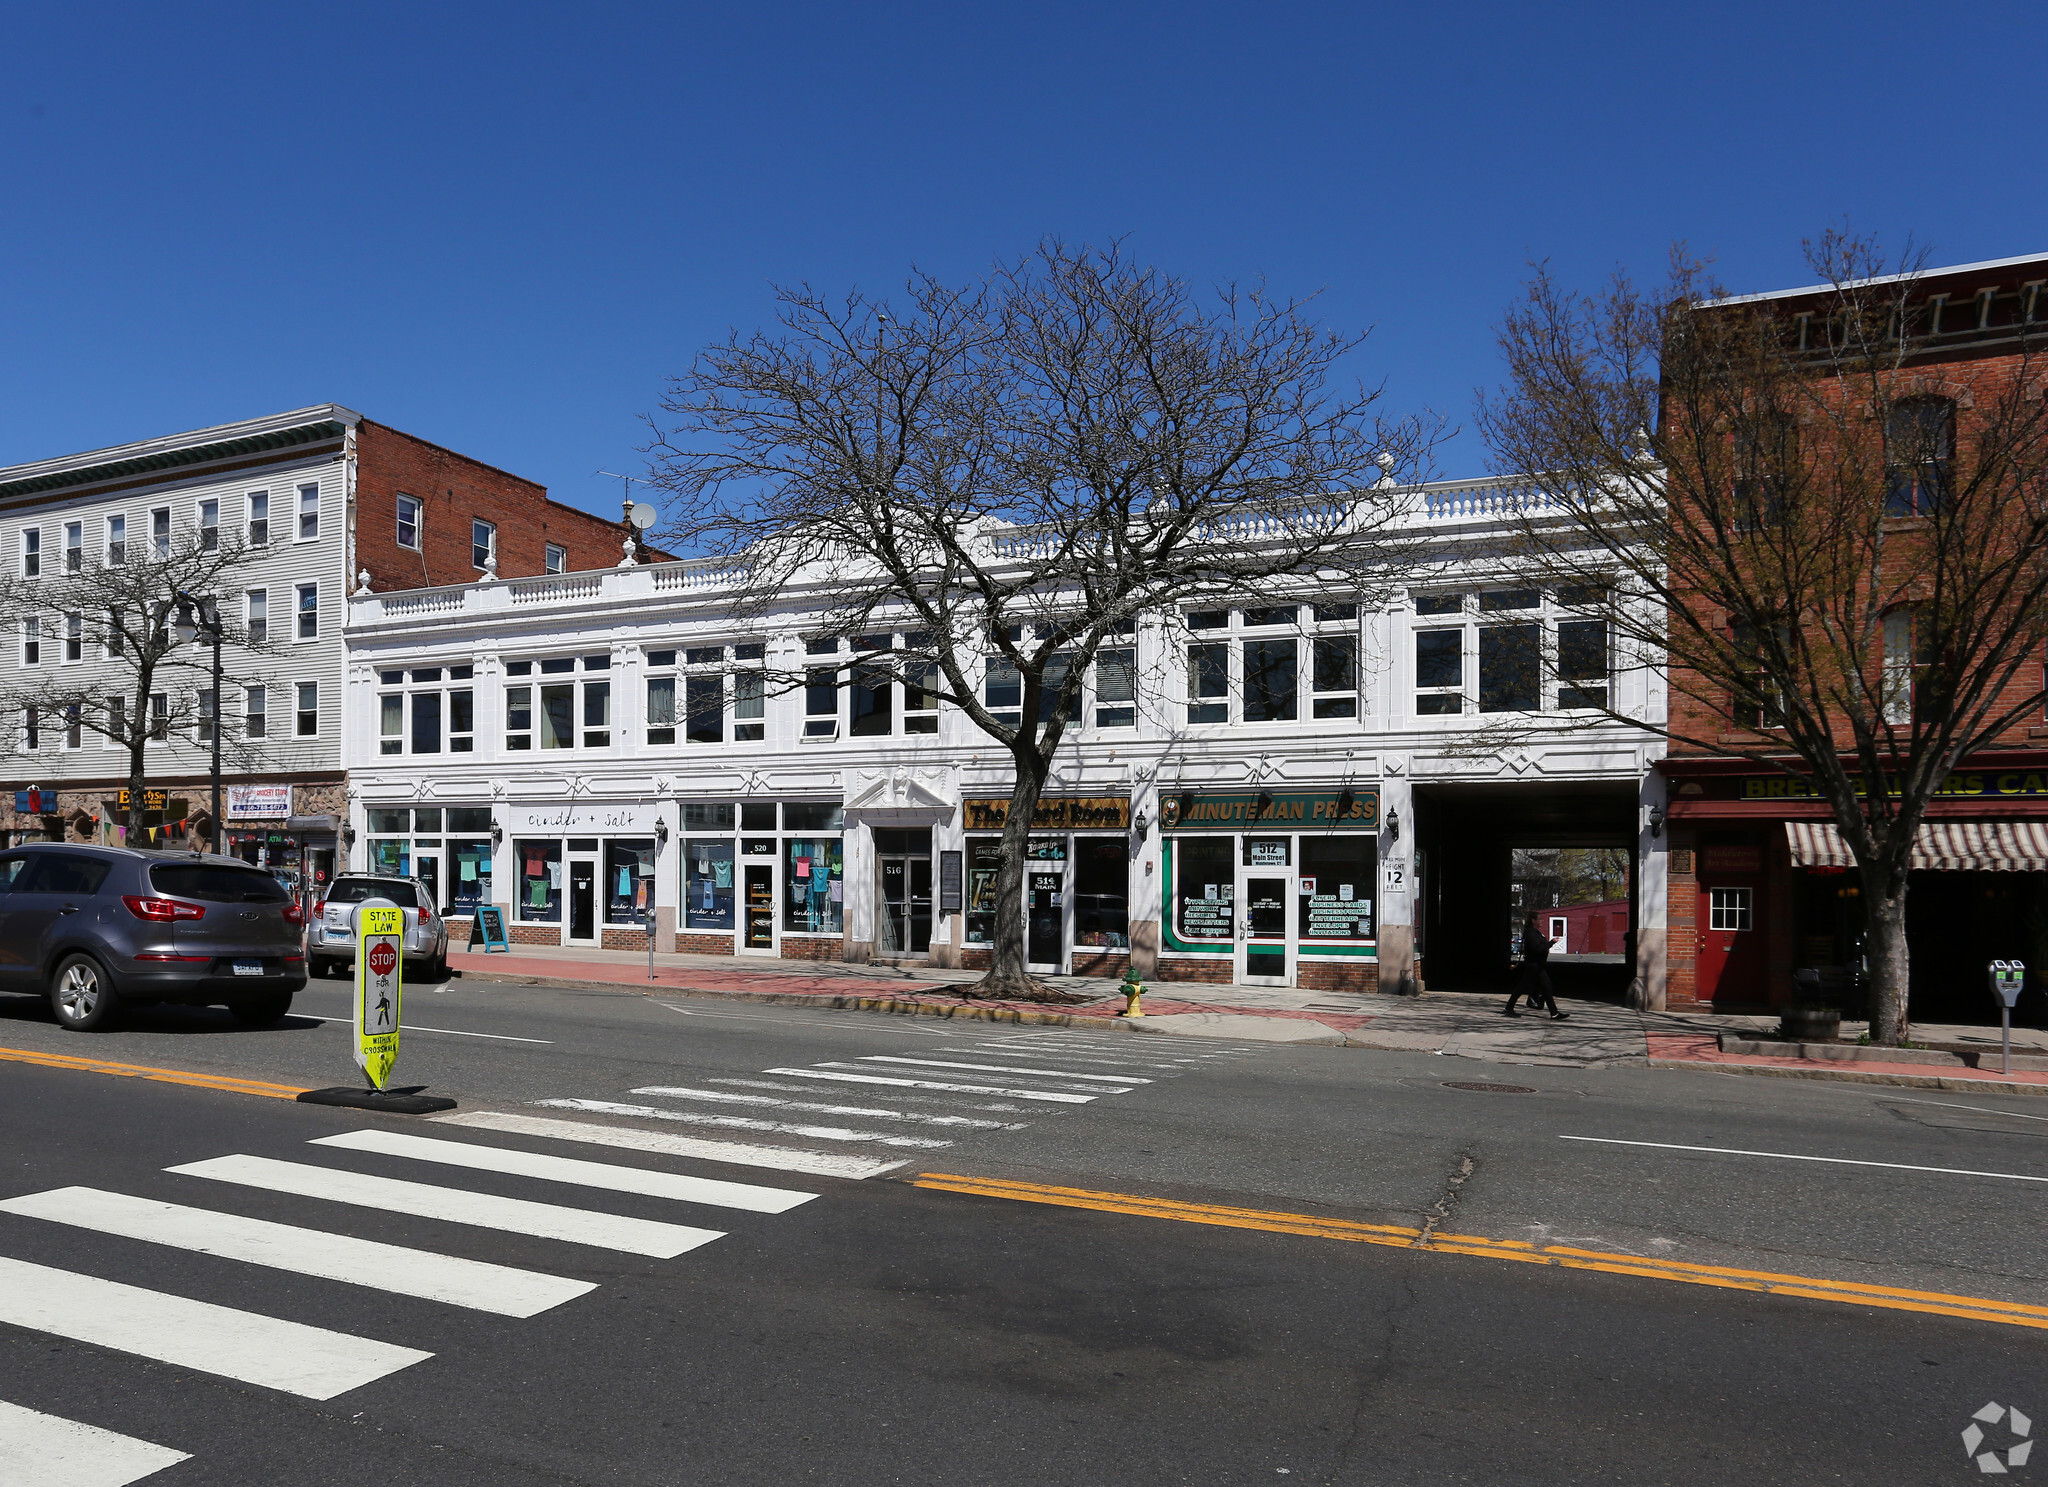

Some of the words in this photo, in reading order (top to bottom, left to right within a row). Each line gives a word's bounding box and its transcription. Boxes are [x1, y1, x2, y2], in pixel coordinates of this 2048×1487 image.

[1997, 774, 2048, 794] CA
[970, 804, 1005, 821] The
[1069, 803, 1121, 821] Room
[1183, 801, 1305, 820] MINUTEMAN
[1312, 800, 1377, 819] PRESS
[1259, 843, 1277, 854] 512
[886, 866, 902, 874] 516
[1387, 871, 1403, 884] 12
[370, 911, 396, 921] STATE
[374, 923, 393, 933] LAW
[1200, 927, 1229, 935] SERVICES
[371, 953, 395, 966] STOP
[376, 980, 389, 988] FOR
[372, 1036, 391, 1045] WITHIN
[363, 1044, 397, 1055] CROSSWALK
